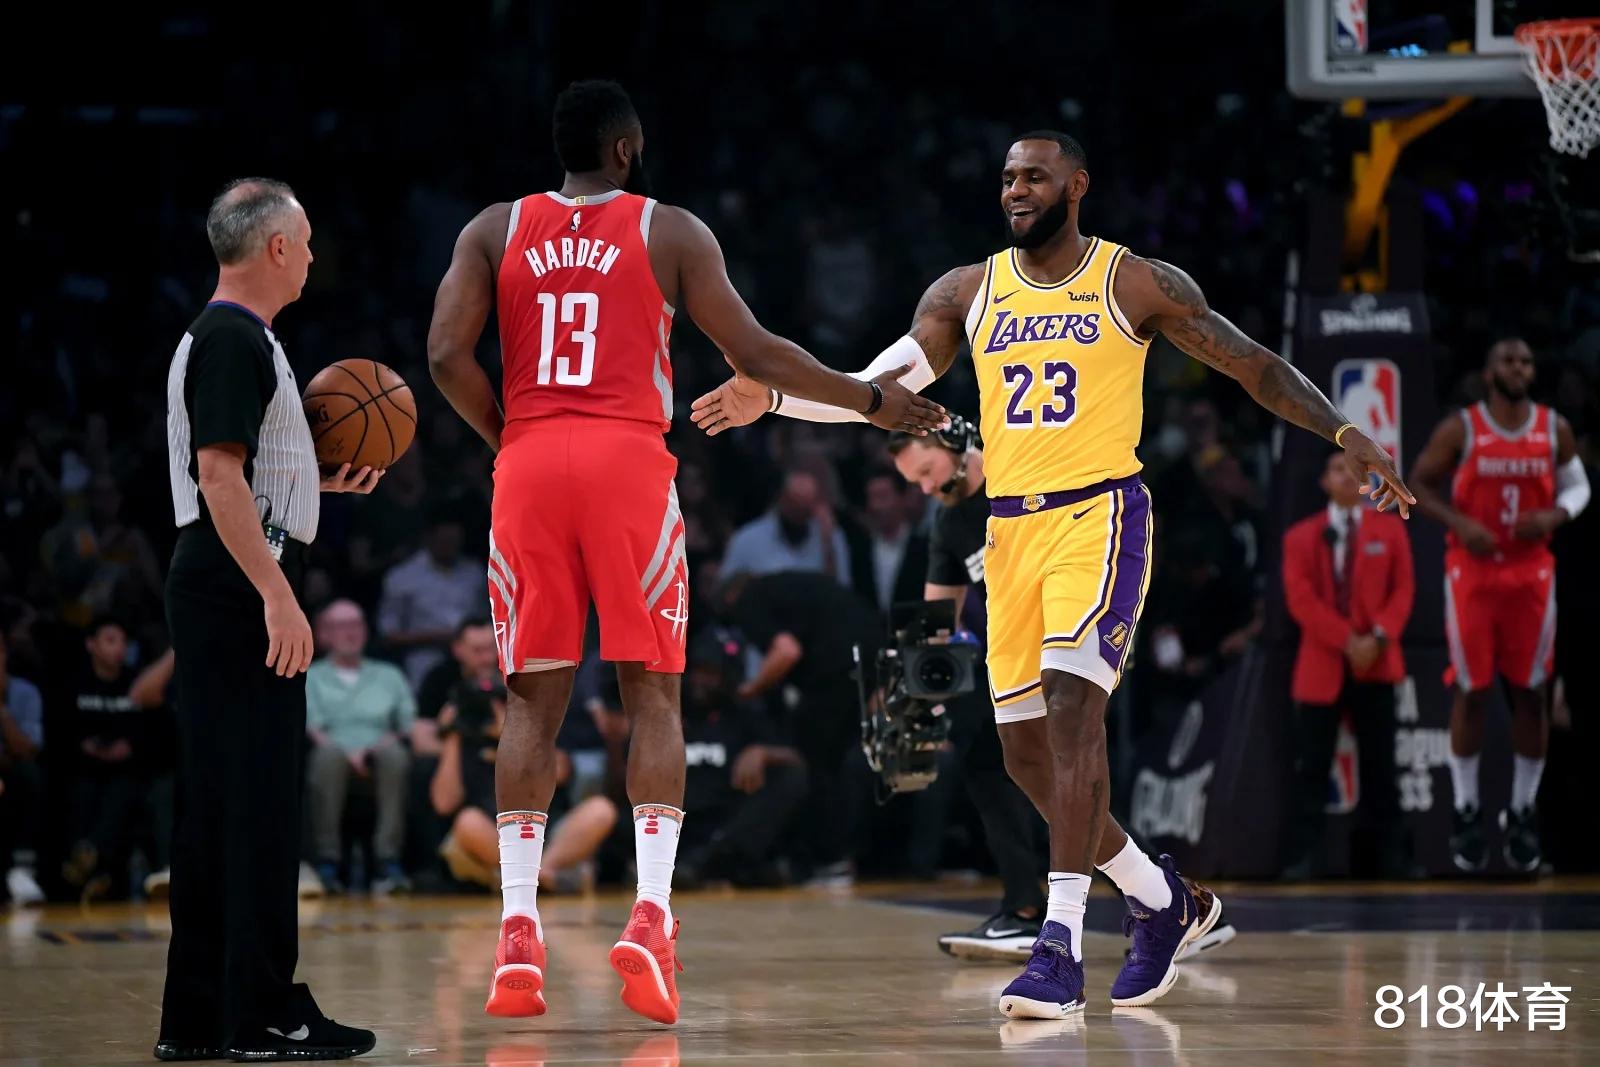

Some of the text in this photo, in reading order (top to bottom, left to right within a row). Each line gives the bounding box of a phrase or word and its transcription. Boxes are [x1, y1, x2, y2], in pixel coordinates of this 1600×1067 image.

[524, 237, 621, 278] HARDEN
[1067, 291, 1099, 302] wish
[536, 292, 600, 387] 13
[983, 310, 1101, 354] LAKERS
[1002, 361, 1078, 428] 23
[1501, 483, 1520, 525] 3
